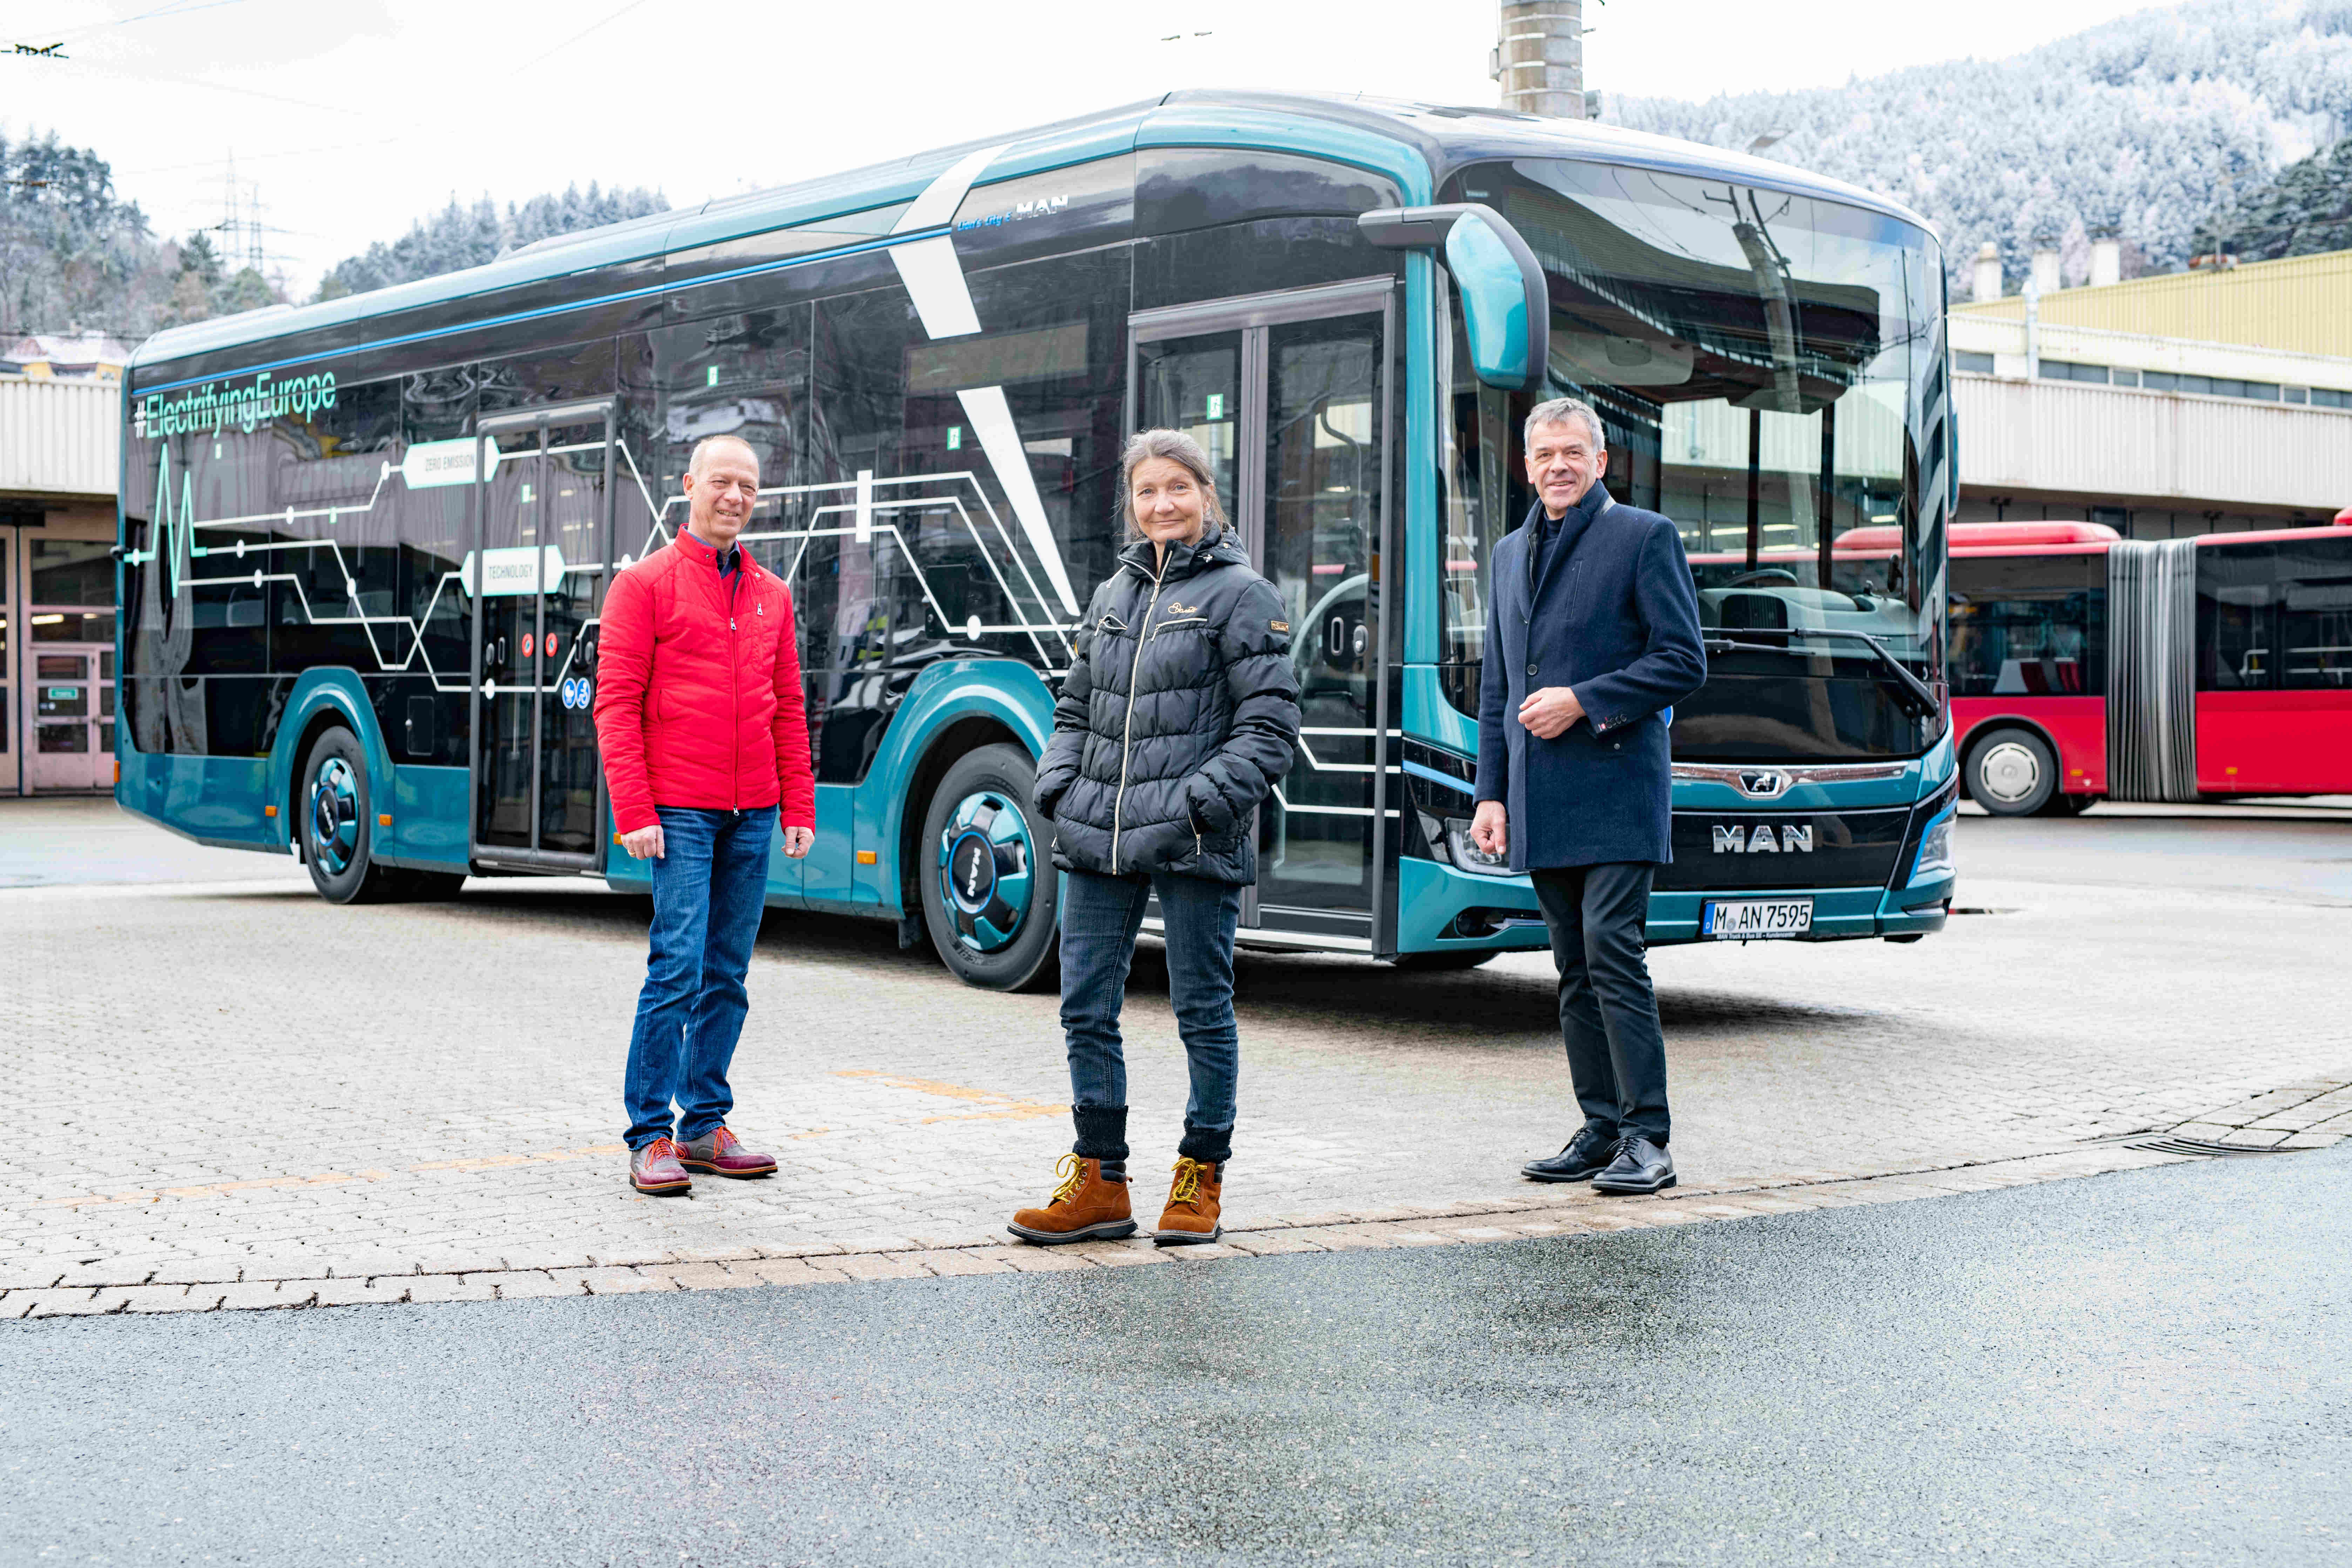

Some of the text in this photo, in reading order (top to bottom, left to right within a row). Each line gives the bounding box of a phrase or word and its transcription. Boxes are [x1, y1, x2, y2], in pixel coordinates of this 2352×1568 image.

[984, 214, 1003, 227] City
[1016, 194, 1069, 221] MAN
[134, 371, 336, 439] #ElectrifyingEurope
[425, 454, 475, 472] ZERO EMISSION
[488, 564, 533, 580] TECHNOLOGY
[1713, 825, 1812, 852] MAN
[967, 847, 981, 897] MAN
[1714, 905, 1810, 930] M AN 7595
